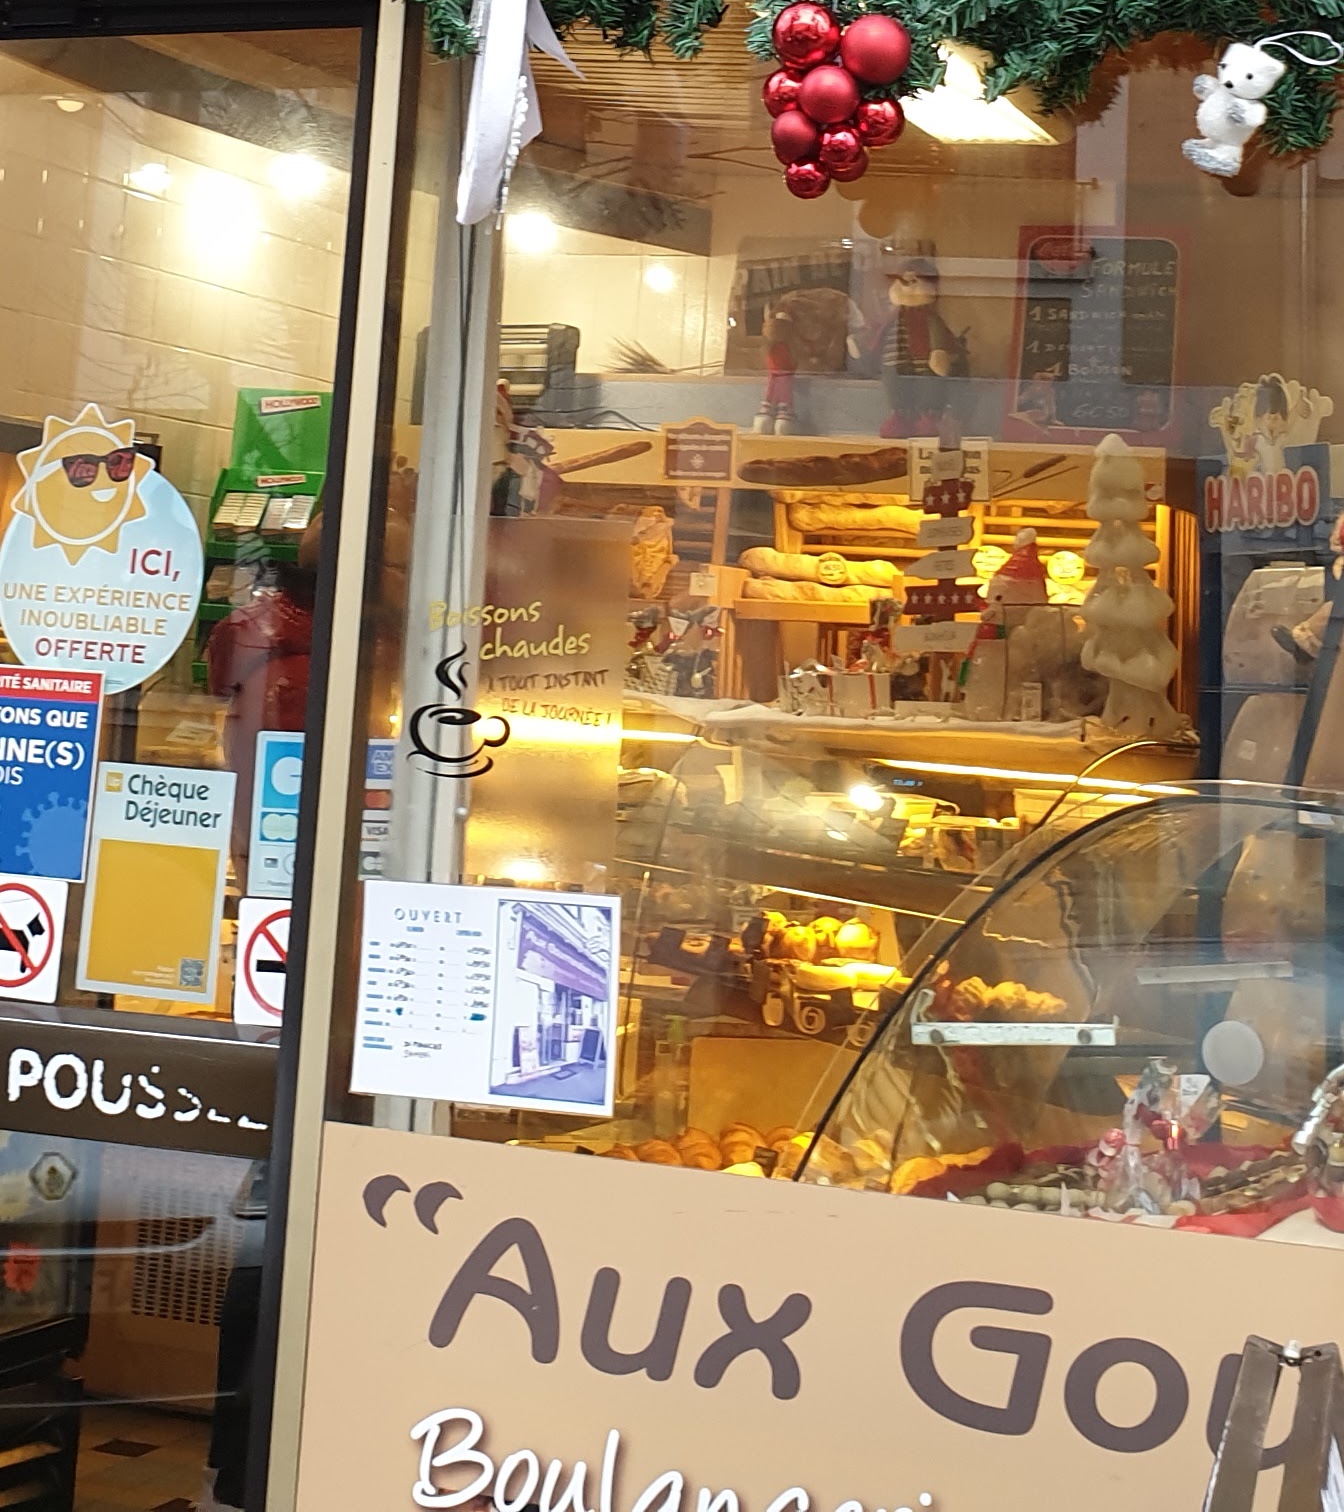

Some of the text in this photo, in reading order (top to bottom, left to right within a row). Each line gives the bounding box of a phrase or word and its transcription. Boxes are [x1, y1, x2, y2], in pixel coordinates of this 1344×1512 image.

[1204, 464, 1320, 533] HARIBO
[130, 547, 180, 582] ICI,
[3, 582, 191, 612] UNE EXPÉRIENCE
[20, 609, 168, 636] INOUBLIABLE
[429, 600, 543, 631] Boissons
[35, 637, 147, 664] OFFERTE
[479, 624, 592, 660] chaudes
[23, 676, 93, 694] SANITAIRE
[45, 709, 90, 729] QUE
[127, 772, 210, 803] Chèque
[124, 800, 222, 830] Déjeuner
[393, 907, 463, 924] OUVERT
